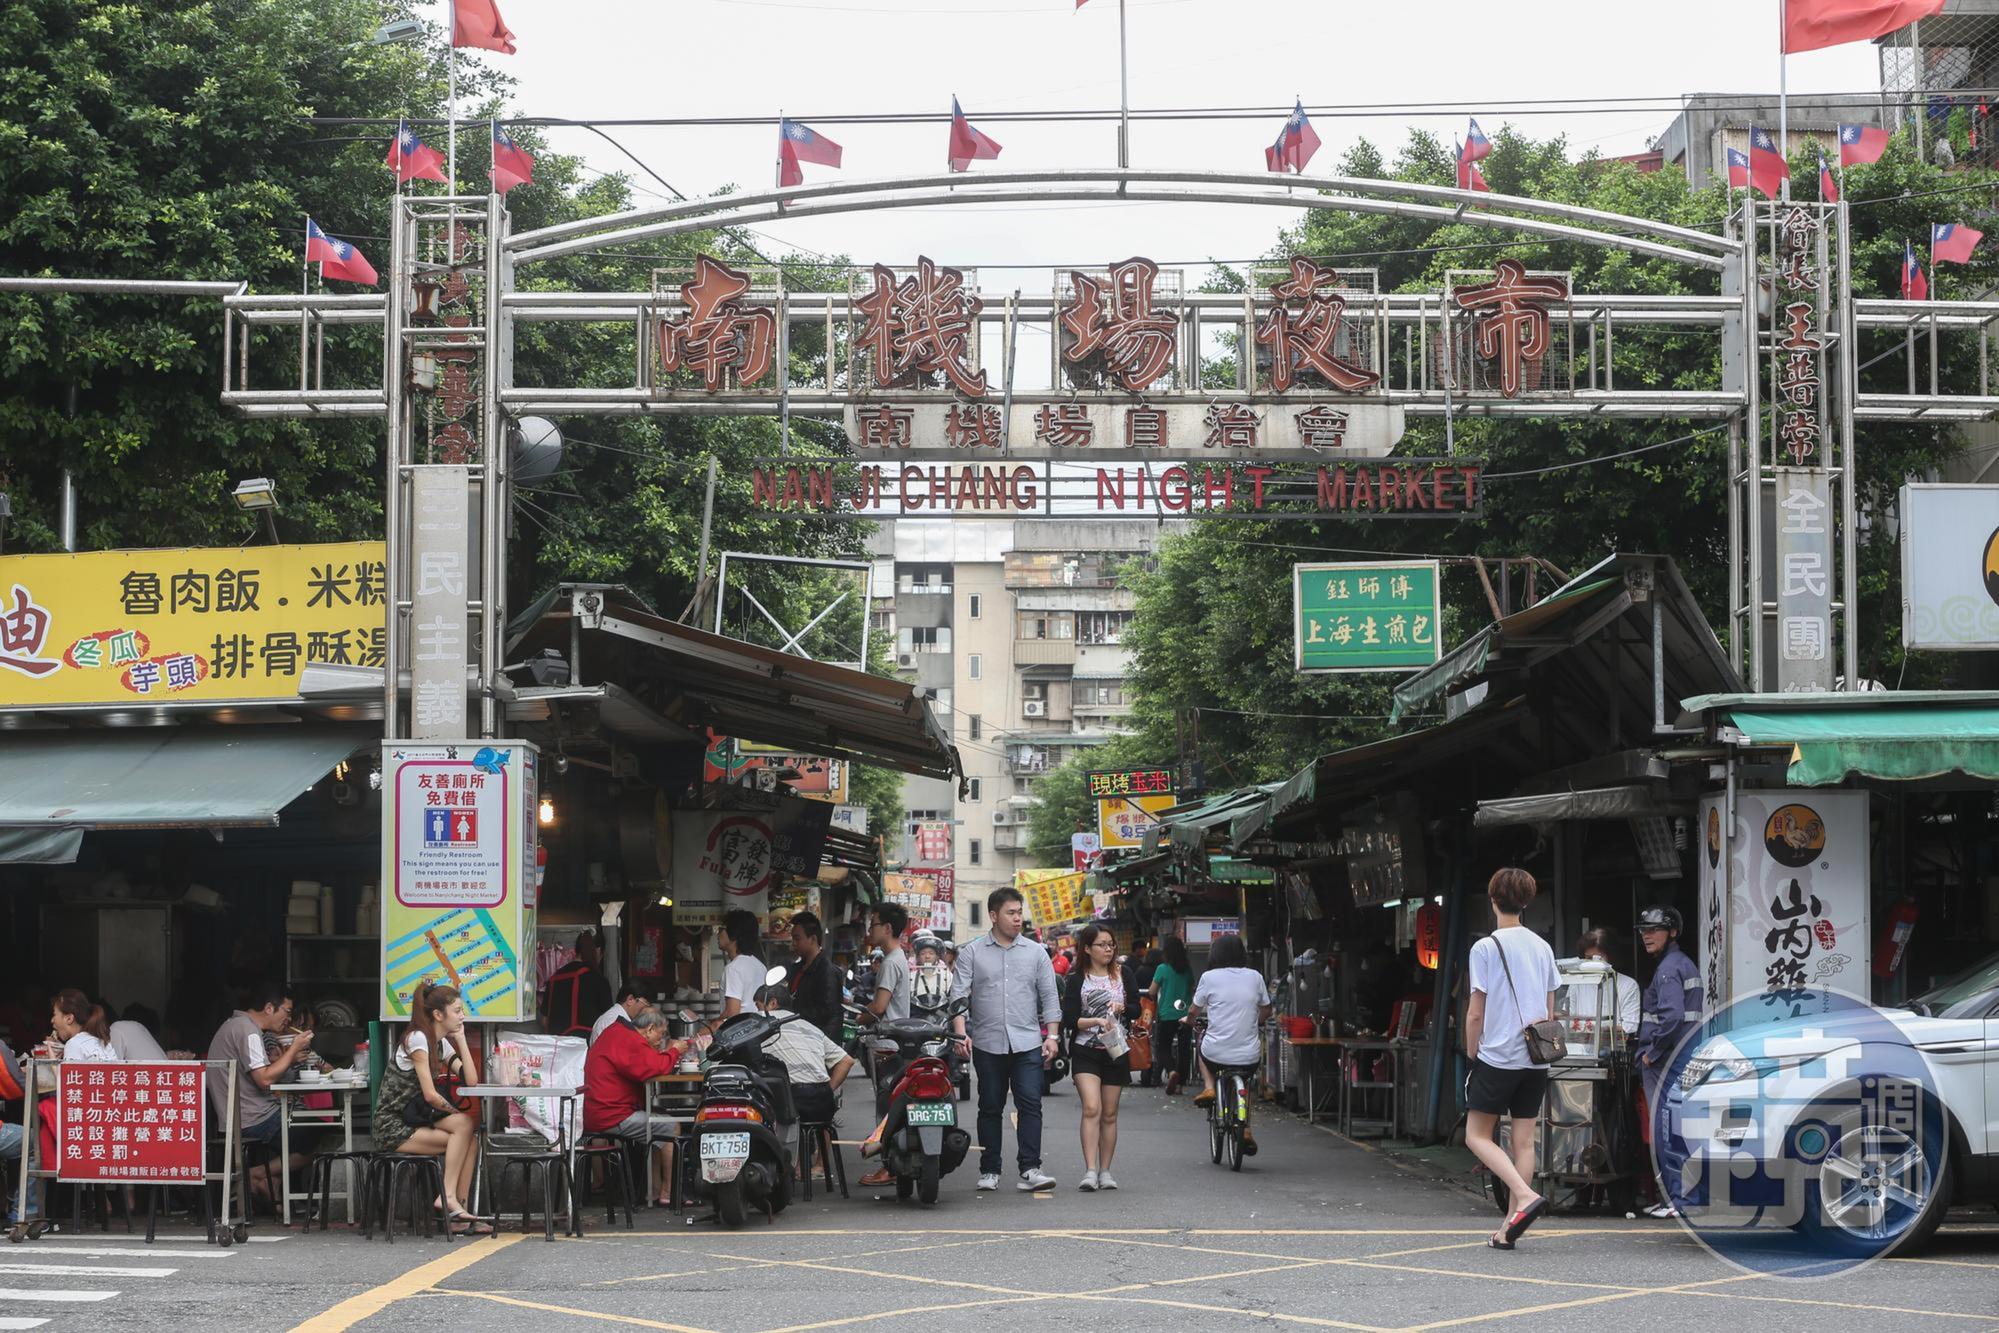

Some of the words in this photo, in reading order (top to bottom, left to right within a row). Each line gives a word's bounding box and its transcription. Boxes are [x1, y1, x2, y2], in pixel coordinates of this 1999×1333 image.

[659, 252, 1568, 398] 南機場夜市
[857, 403, 1350, 450] 南機場自治會
[751, 464, 833, 510] NAN
[850, 464, 881, 510] JI
[902, 464, 1037, 511] CHANG
[1096, 465, 1274, 511] NIGHT
[1316, 465, 1481, 511] MARKET
[1780, 488, 1826, 692] 全民團
[416, 486, 463, 726] 三民主義
[1305, 614, 1432, 645] 上海生煎包
[73, 630, 139, 666] 冬瓜
[130, 654, 197, 693] 芋頭
[1092, 770, 1169, 794] 現烤玉米
[426, 790, 477, 806] 免費借
[419, 851, 447, 859] Friendly
[414, 881, 459, 890] 南機場夜市
[66, 1089, 196, 1105] 禁止停車區域
[66, 1108, 198, 1122] 請勿於此處停車
[67, 1125, 197, 1143] 或設攤營業以
